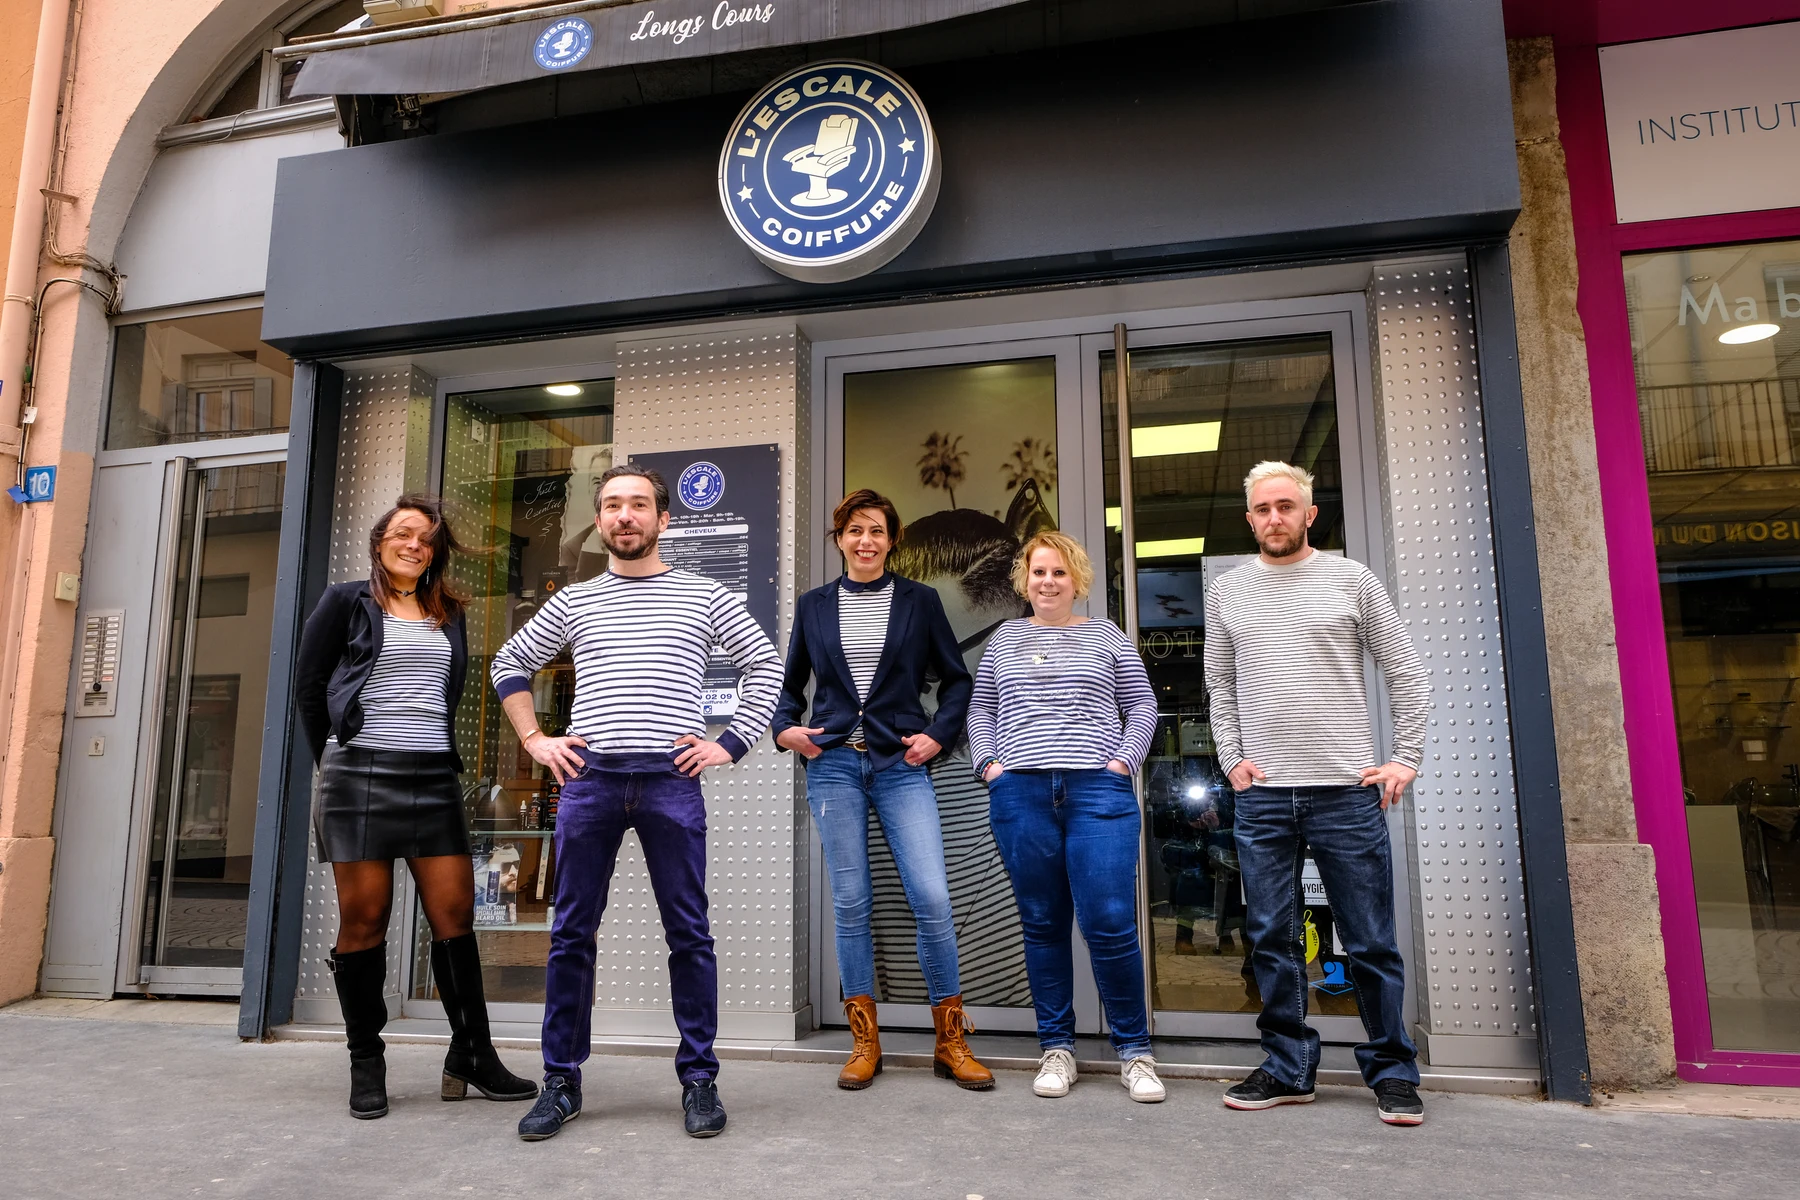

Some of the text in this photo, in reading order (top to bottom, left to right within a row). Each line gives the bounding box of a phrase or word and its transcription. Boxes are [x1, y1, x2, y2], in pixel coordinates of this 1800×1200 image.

[538, 21, 585, 48] L'ESCALE
[630, 0, 776, 45] Longs Cours
[545, 46, 586, 67] COIFFURE
[737, 74, 902, 158] L'ESCALE
[1638, 100, 1800, 146] INSTITUT
[762, 180, 905, 248] COIFFURE
[1678, 281, 1759, 326] Ma
[29, 471, 51, 497] 10
[682, 466, 718, 485] L'ESCALE
[688, 490, 718, 506] COIFFURE
[684, 527, 717, 535] CHEVEUX
